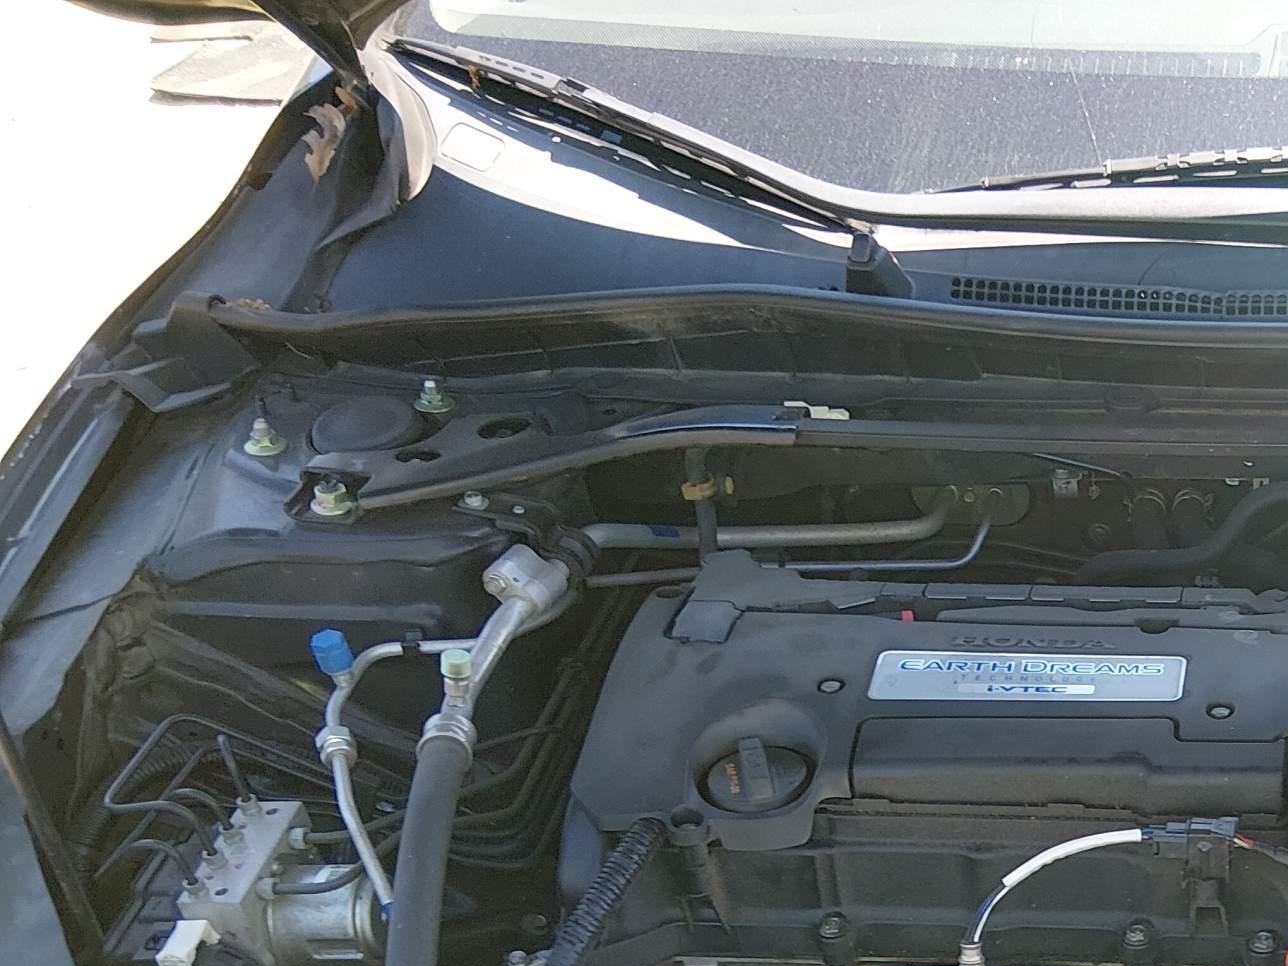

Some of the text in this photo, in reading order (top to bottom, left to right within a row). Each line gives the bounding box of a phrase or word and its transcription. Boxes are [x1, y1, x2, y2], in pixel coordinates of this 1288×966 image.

[952, 636, 1115, 648] HONDA
[900, 659, 1165, 675] EARTH DREAMS
[986, 685, 1068, 693] i-VTEC
